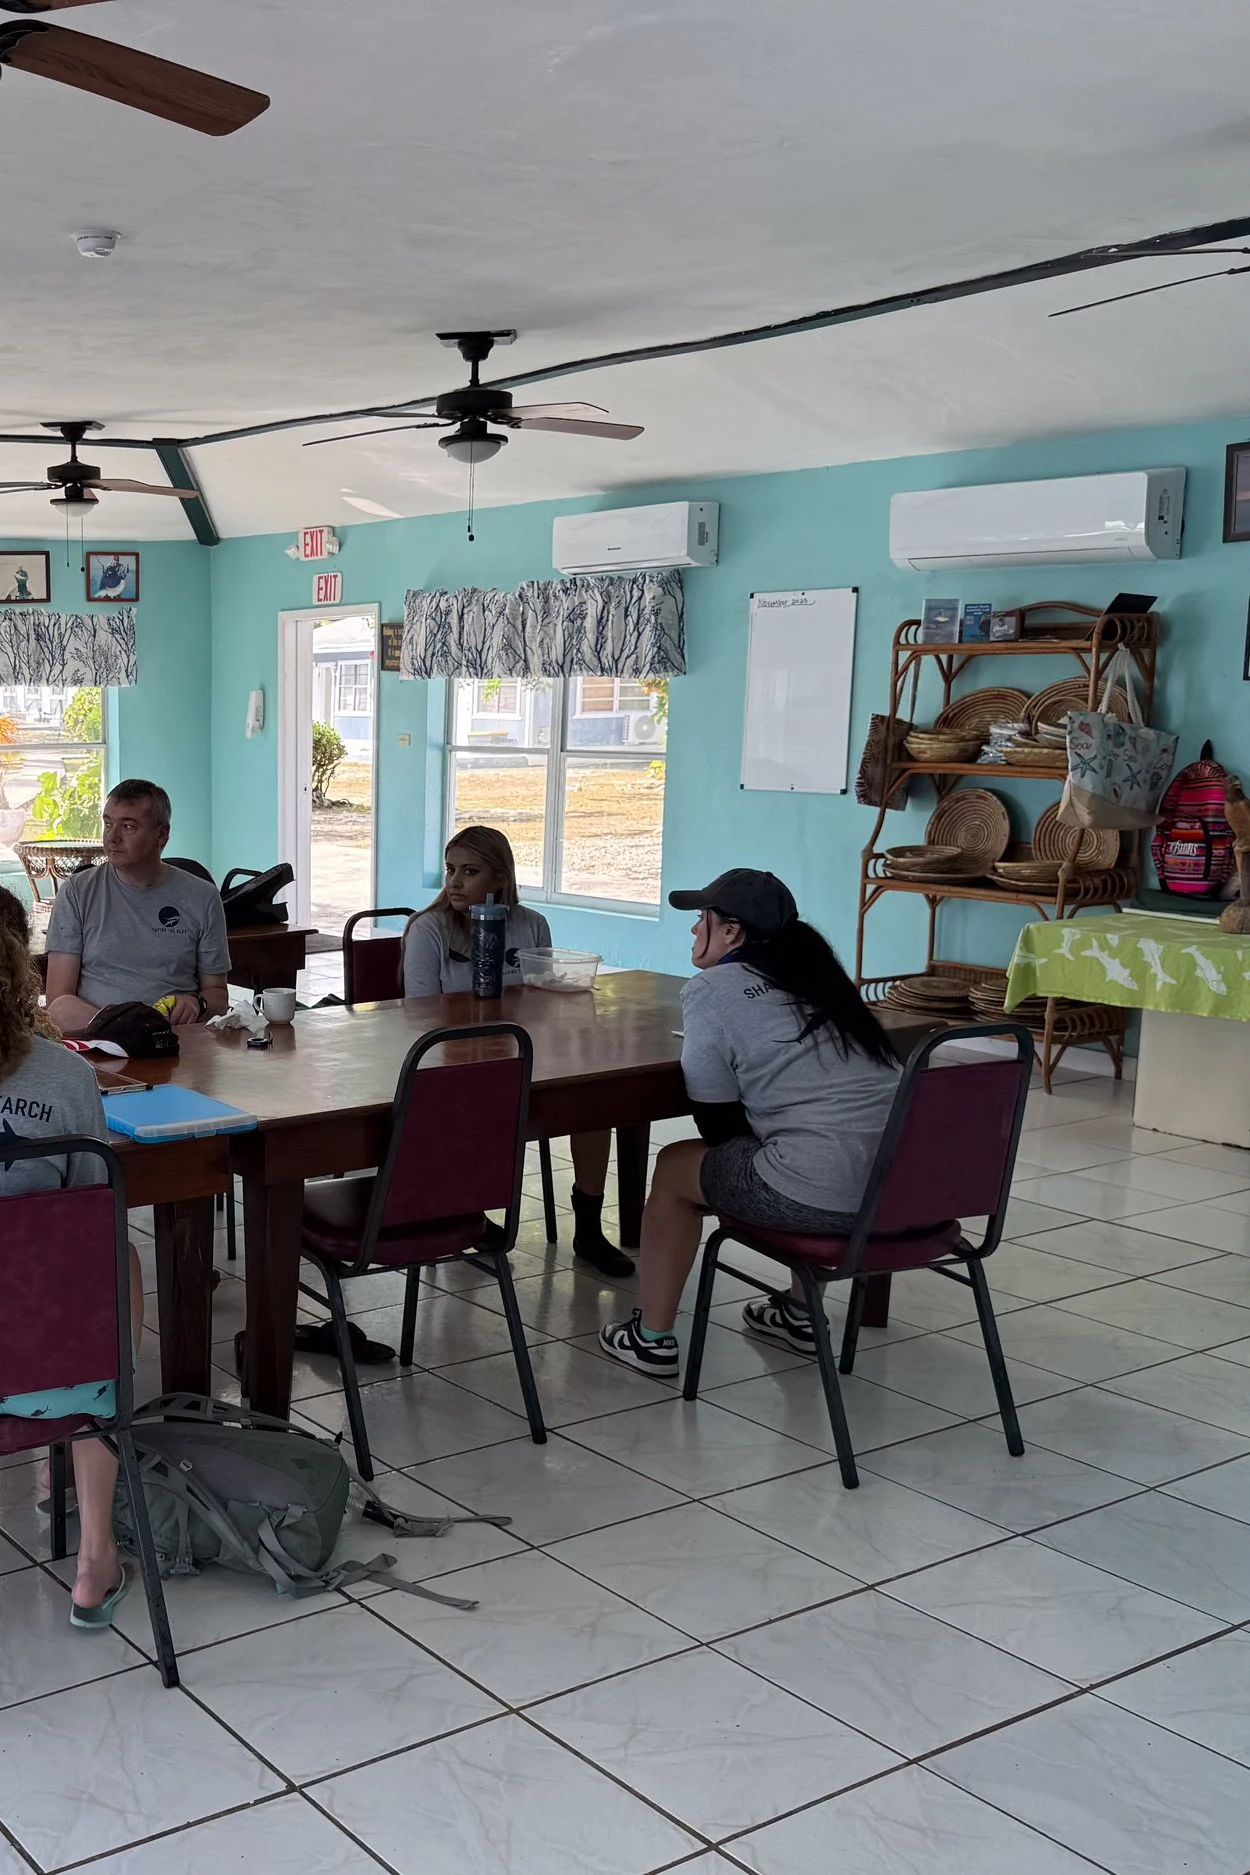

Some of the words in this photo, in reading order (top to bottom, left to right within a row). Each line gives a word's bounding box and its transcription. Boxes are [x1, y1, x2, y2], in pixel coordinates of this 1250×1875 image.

[303, 529, 324, 558] EXIT
[317, 574, 338, 602] EXIT
[743, 982, 775, 999] SHA
